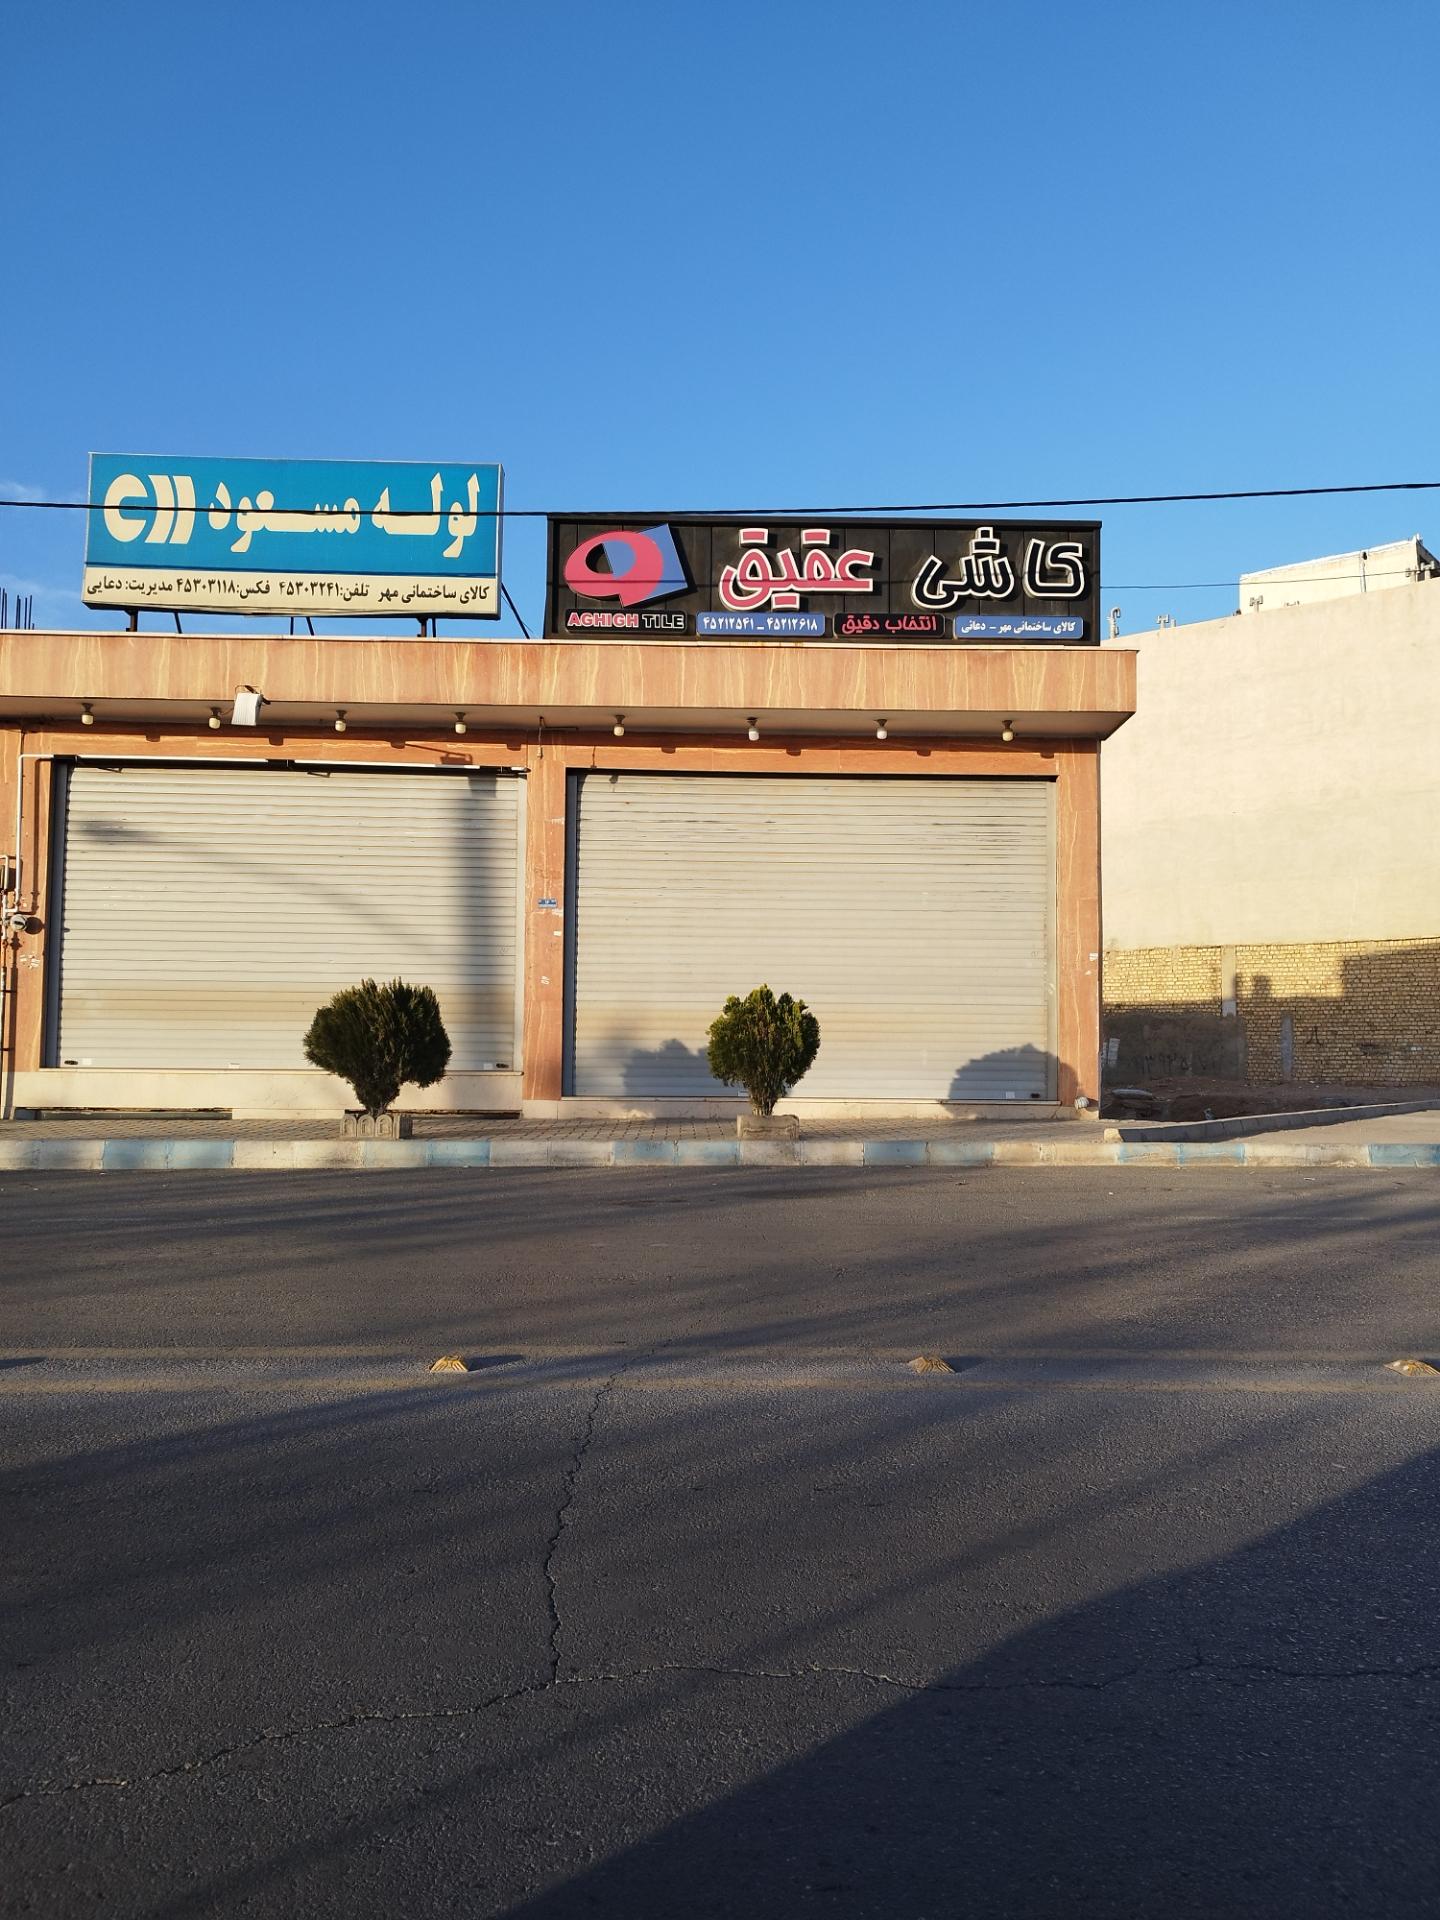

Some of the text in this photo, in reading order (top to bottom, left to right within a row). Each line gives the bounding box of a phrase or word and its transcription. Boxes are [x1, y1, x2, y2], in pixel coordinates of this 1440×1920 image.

[719, 526, 1085, 611] کاشی عقیق
[86, 575, 123, 595] دعایی
[125, 579, 173, 596] مدیریت:
[401, 582, 457, 603] ساختمانی
[377, 588, 399, 603] مهر
[459, 584, 490, 604] کالای
[567, 612, 685, 629] AGHIGH TILE
[841, 614, 937, 635] انتخاب دقیق
[998, 624, 1012, 634] مهر
[1013, 620, 1052, 634] ساختمانی
[1053, 620, 1077, 635] کالای
